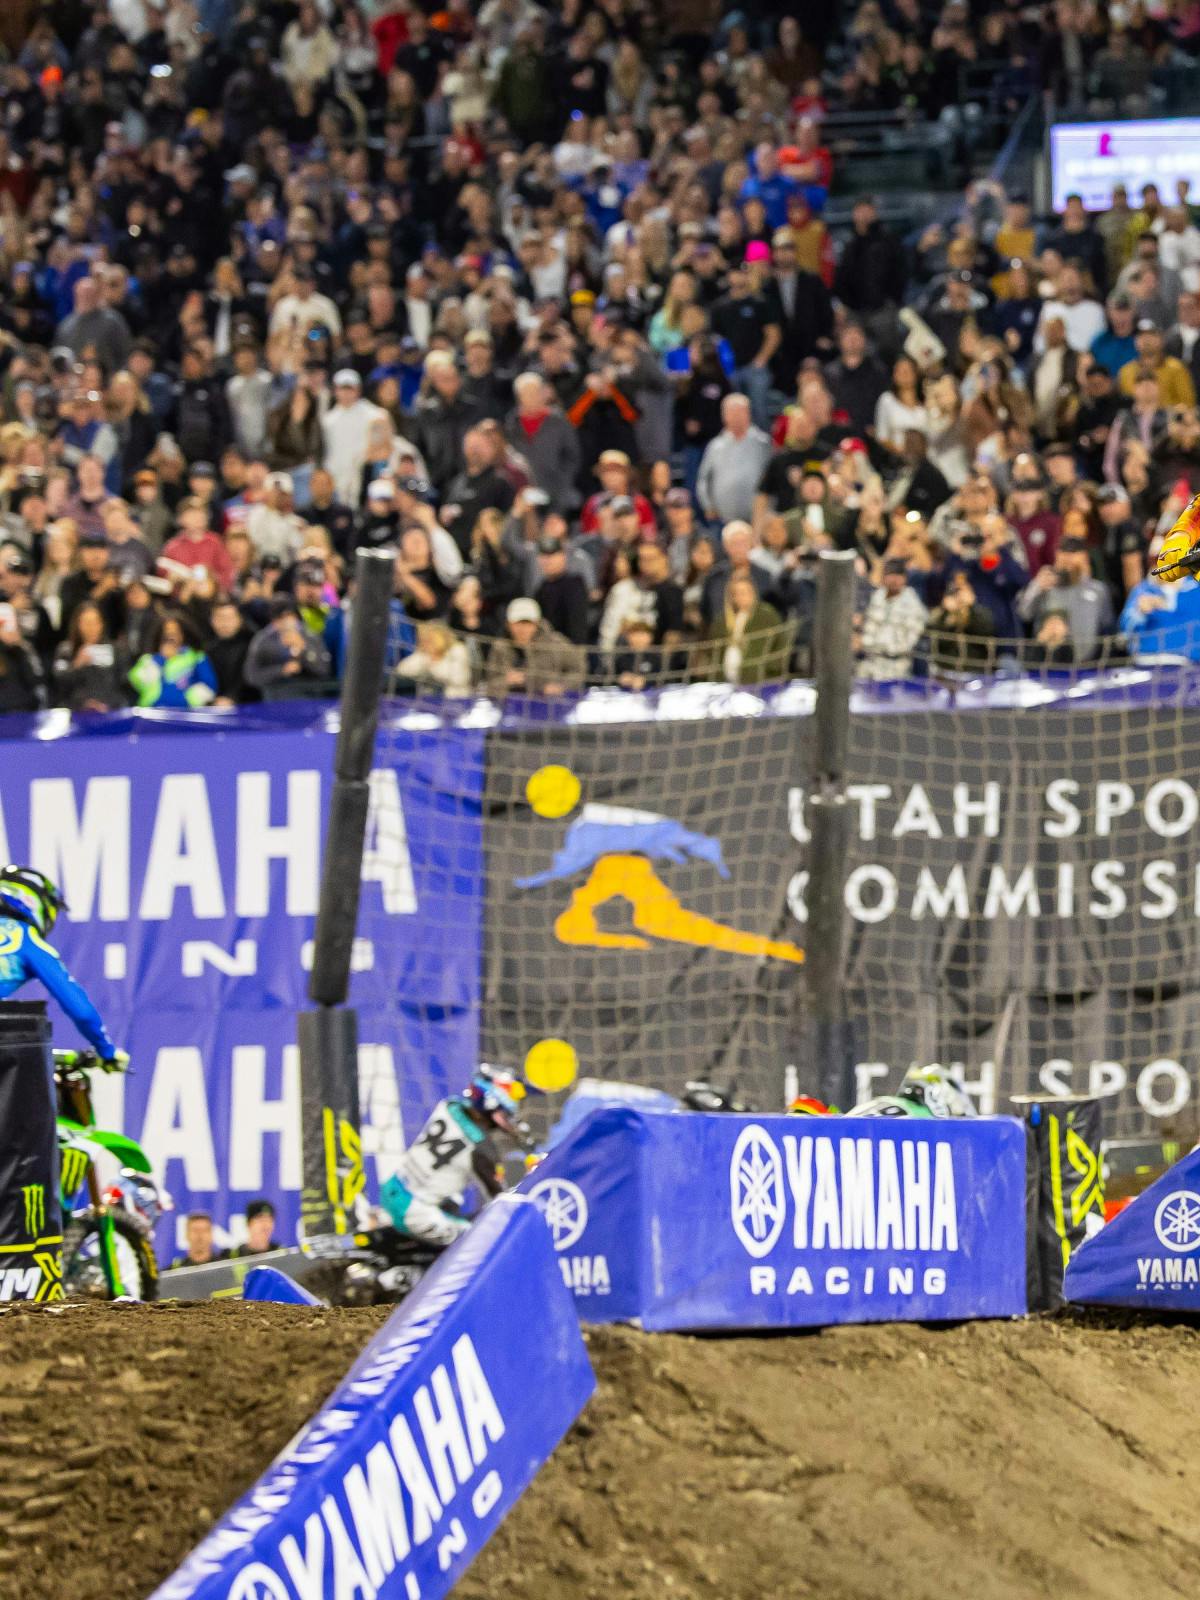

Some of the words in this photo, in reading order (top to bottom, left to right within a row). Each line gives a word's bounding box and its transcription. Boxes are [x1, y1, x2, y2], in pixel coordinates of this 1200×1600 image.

[0, 768, 417, 923] MAHA
[782, 1135, 959, 1252] YAMAHA
[749, 1265, 948, 1296] RACING
[279, 1332, 506, 1600] YAMAHA
